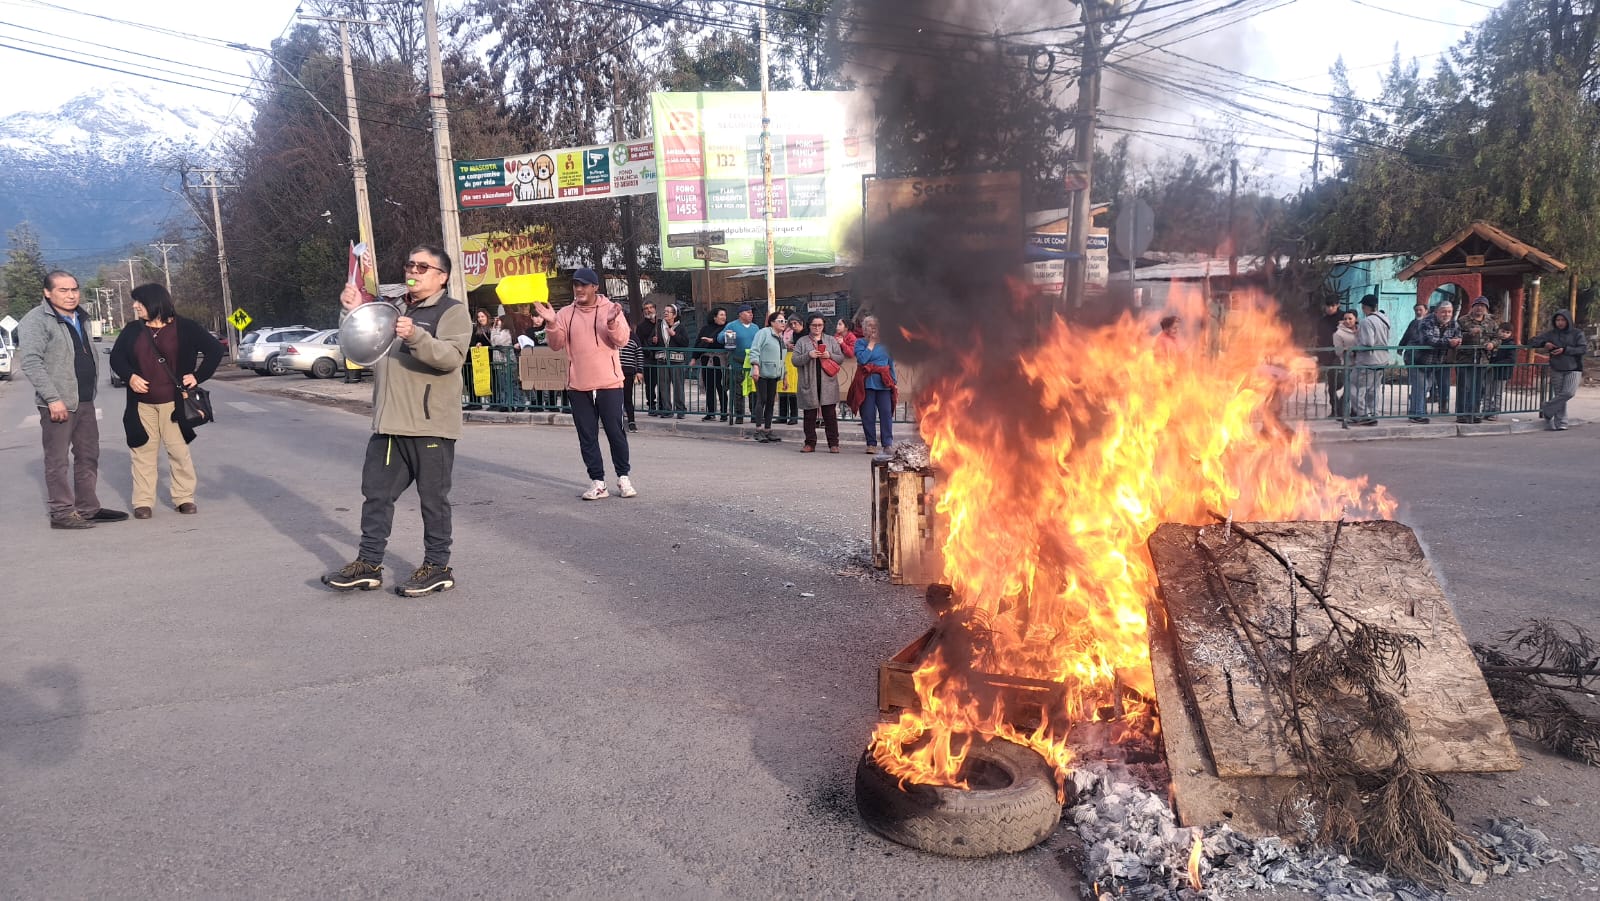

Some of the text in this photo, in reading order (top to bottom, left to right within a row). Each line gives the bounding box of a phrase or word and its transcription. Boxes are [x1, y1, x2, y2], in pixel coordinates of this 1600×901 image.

[716, 153, 736, 167] 132
[472, 180, 483, 188] por
[675, 185, 695, 193] FONO
[568, 187, 579, 196] UTM
[675, 194, 697, 204] MUJER
[676, 203, 698, 215] 1455
[526, 358, 567, 377] HASTA
